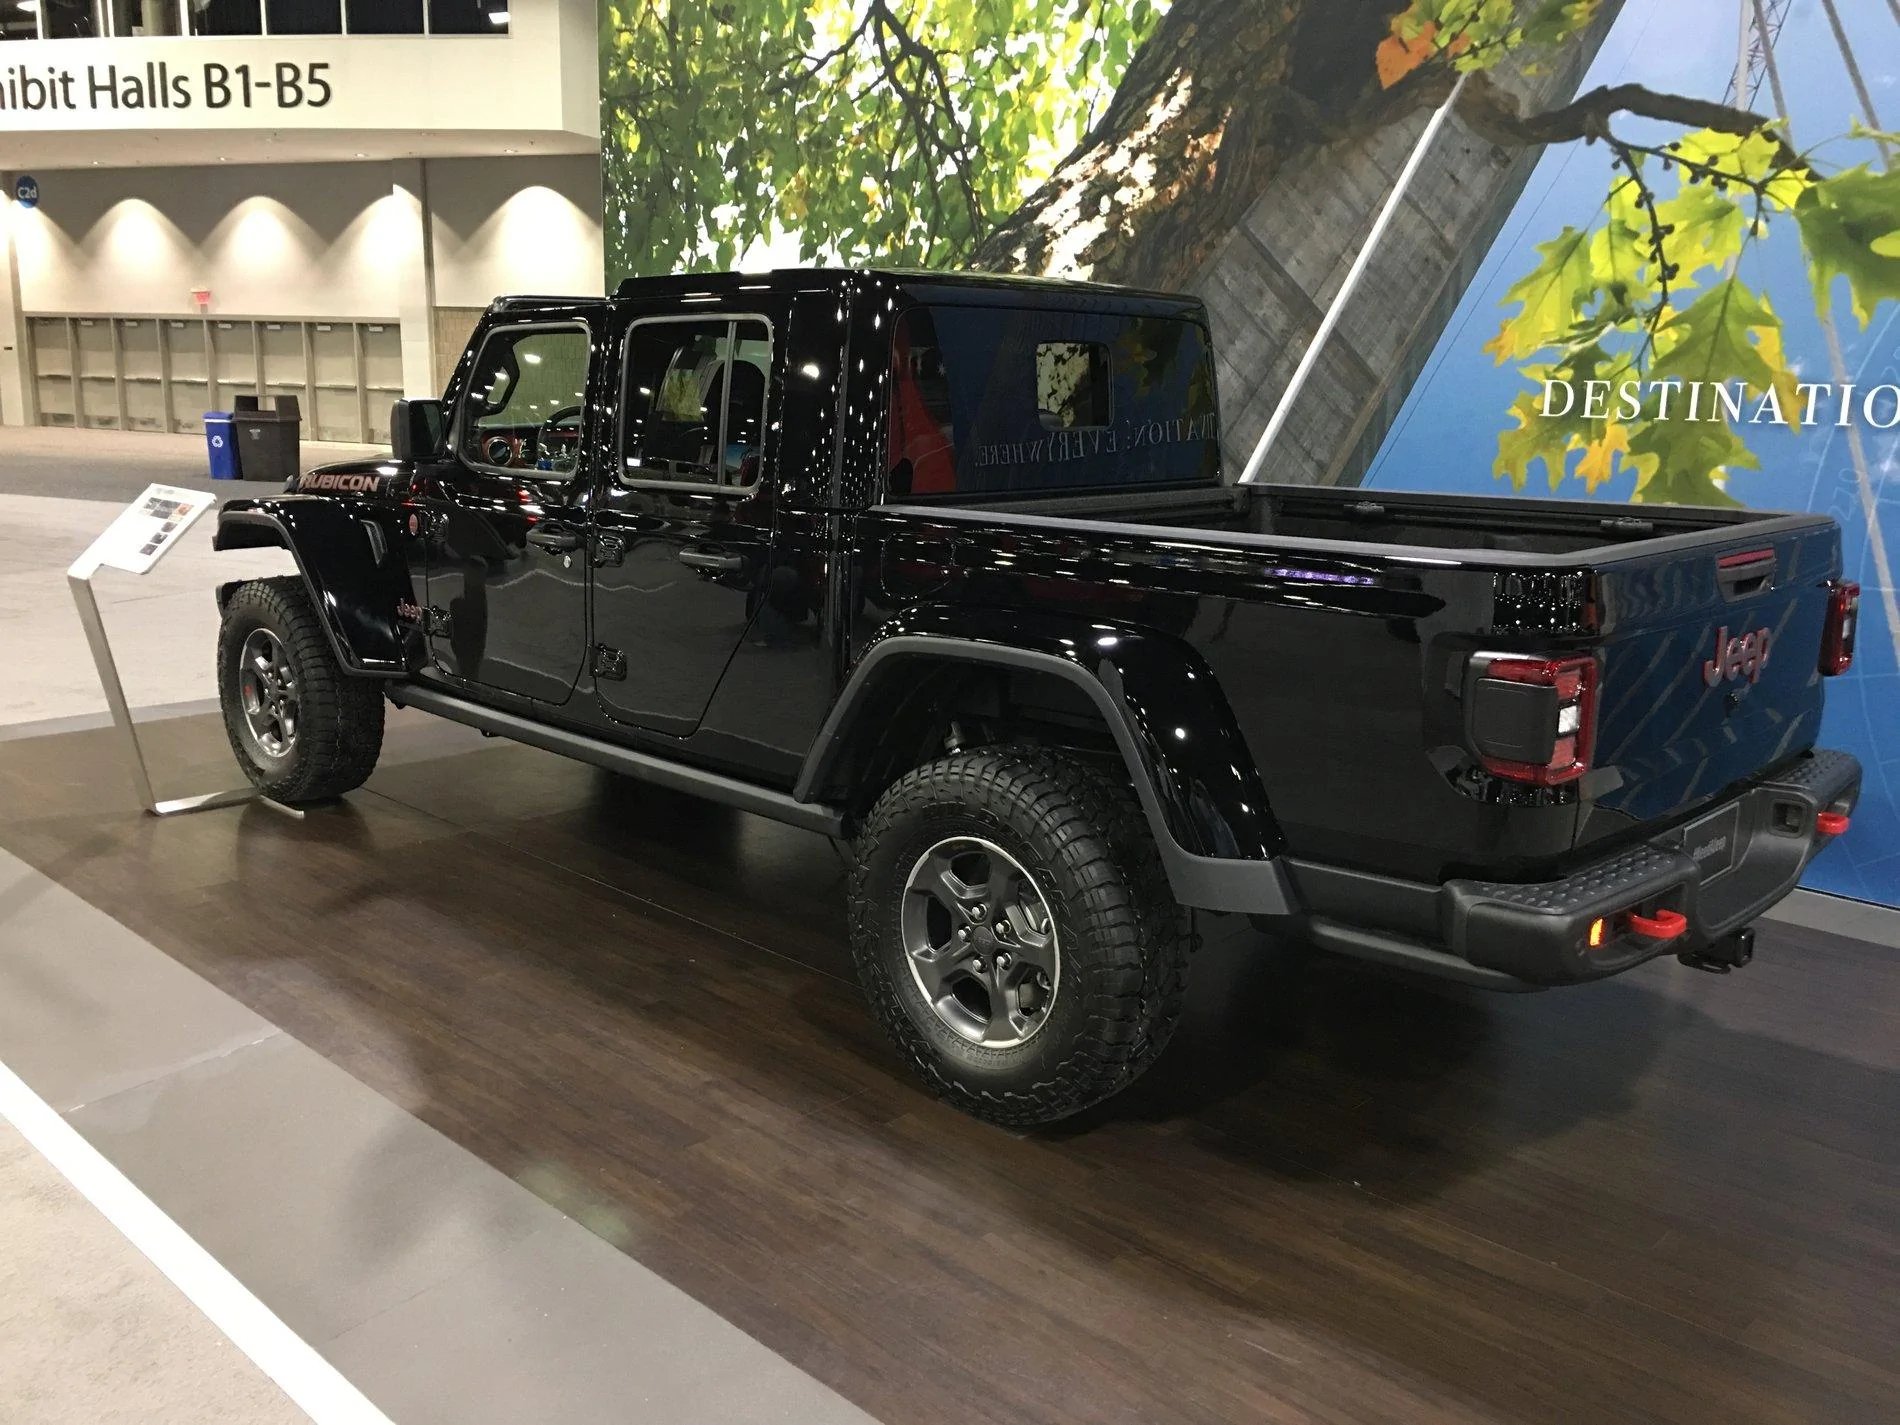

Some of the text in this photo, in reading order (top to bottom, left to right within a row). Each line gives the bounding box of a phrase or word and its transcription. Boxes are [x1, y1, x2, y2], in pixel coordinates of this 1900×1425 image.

[0, 61, 332, 110] ibit Halls B1-B5
[1538, 378, 1900, 429] DESTINATIO
[298, 473, 380, 493] RUBICON
[1702, 625, 1772, 688] Jeep
